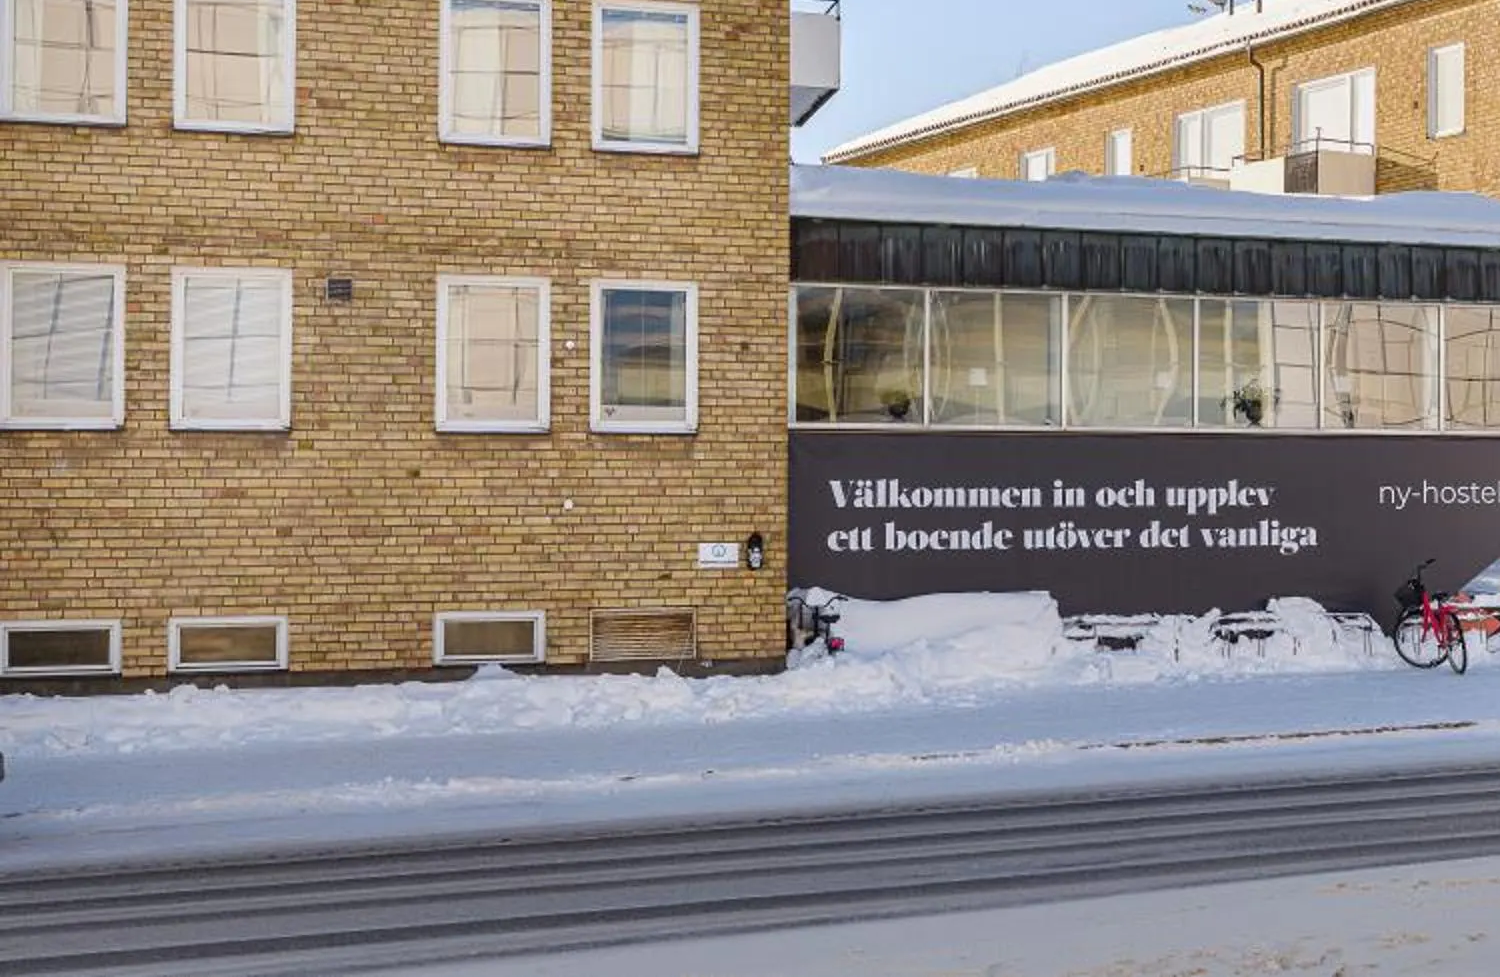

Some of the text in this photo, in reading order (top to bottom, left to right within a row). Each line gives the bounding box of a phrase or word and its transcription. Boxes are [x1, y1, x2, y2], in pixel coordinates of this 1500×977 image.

[829, 478, 1274, 515] Välkommen in och upplev
[827, 519, 1318, 555] ett boende utöver det vanliga
